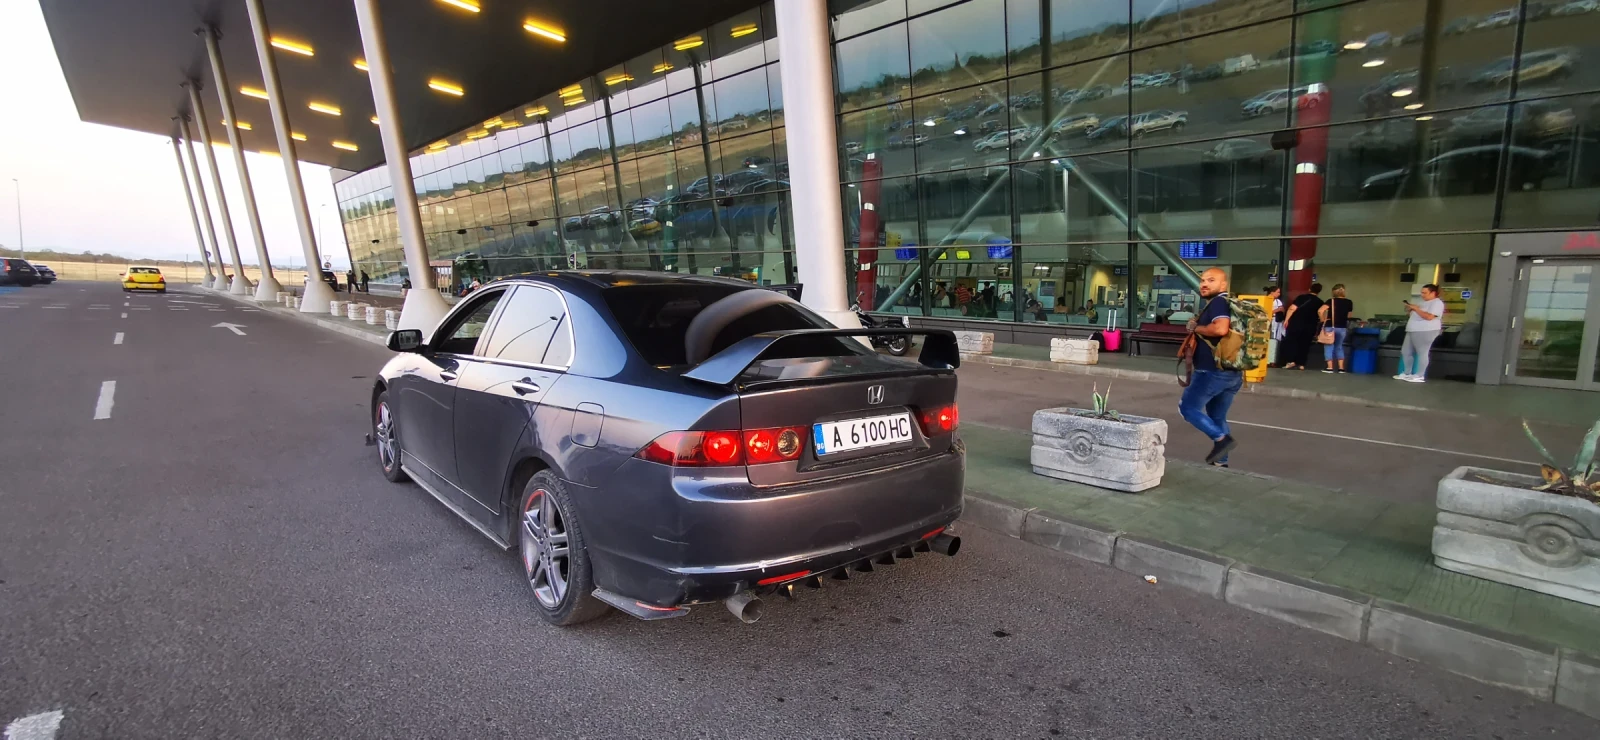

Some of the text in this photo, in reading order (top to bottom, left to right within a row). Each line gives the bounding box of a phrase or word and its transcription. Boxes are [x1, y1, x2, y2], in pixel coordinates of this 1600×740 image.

[833, 417, 909, 448] A 6100 HC
